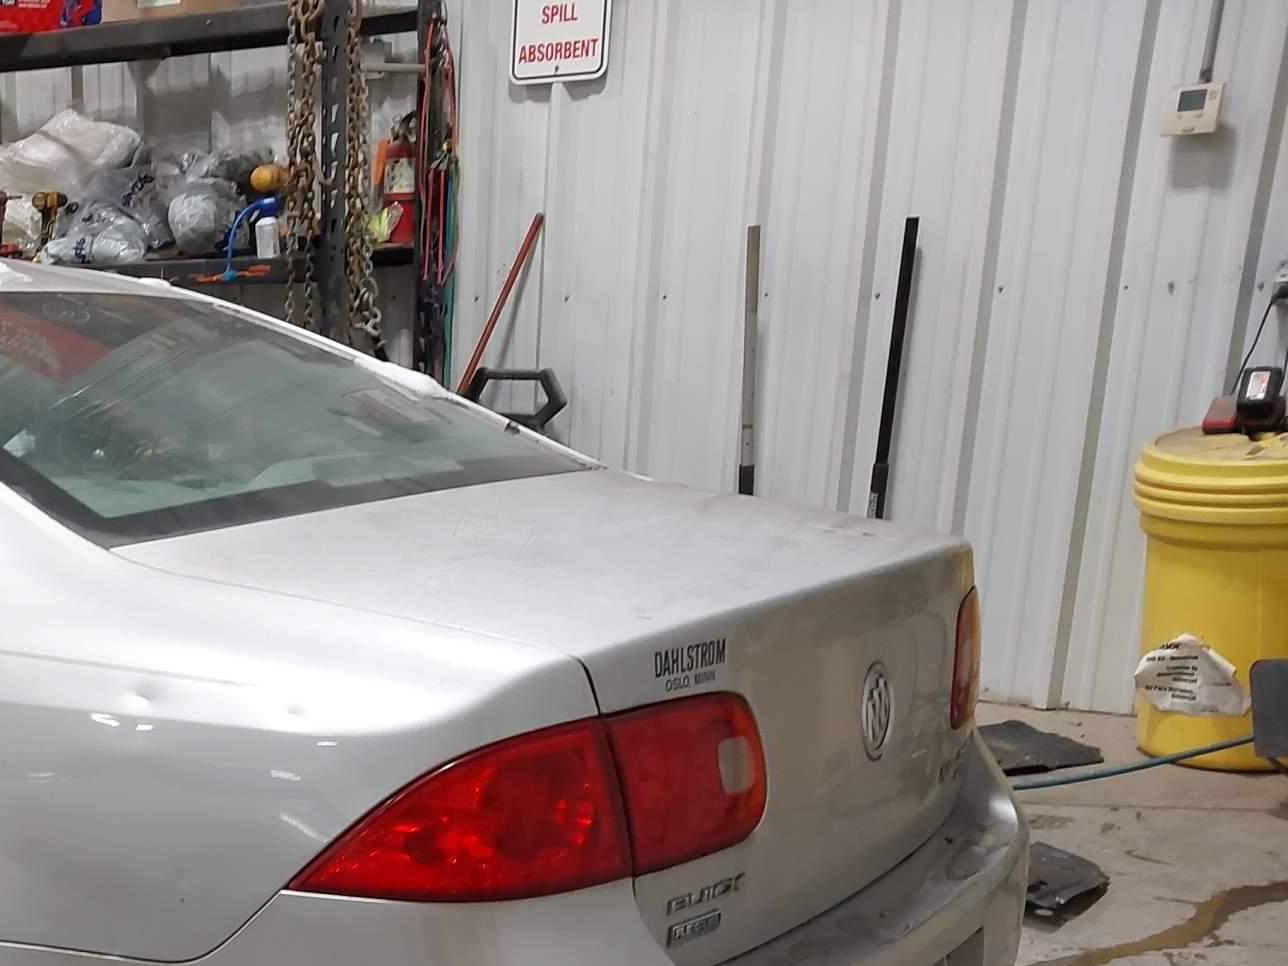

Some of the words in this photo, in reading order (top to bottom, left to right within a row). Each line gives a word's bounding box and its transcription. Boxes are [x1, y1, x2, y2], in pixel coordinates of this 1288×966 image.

[541, 3, 578, 24] SPILL
[518, 38, 599, 64] ABSORBENT
[654, 638, 727, 678] DAHLSTROM
[666, 872, 746, 916] BUICK
